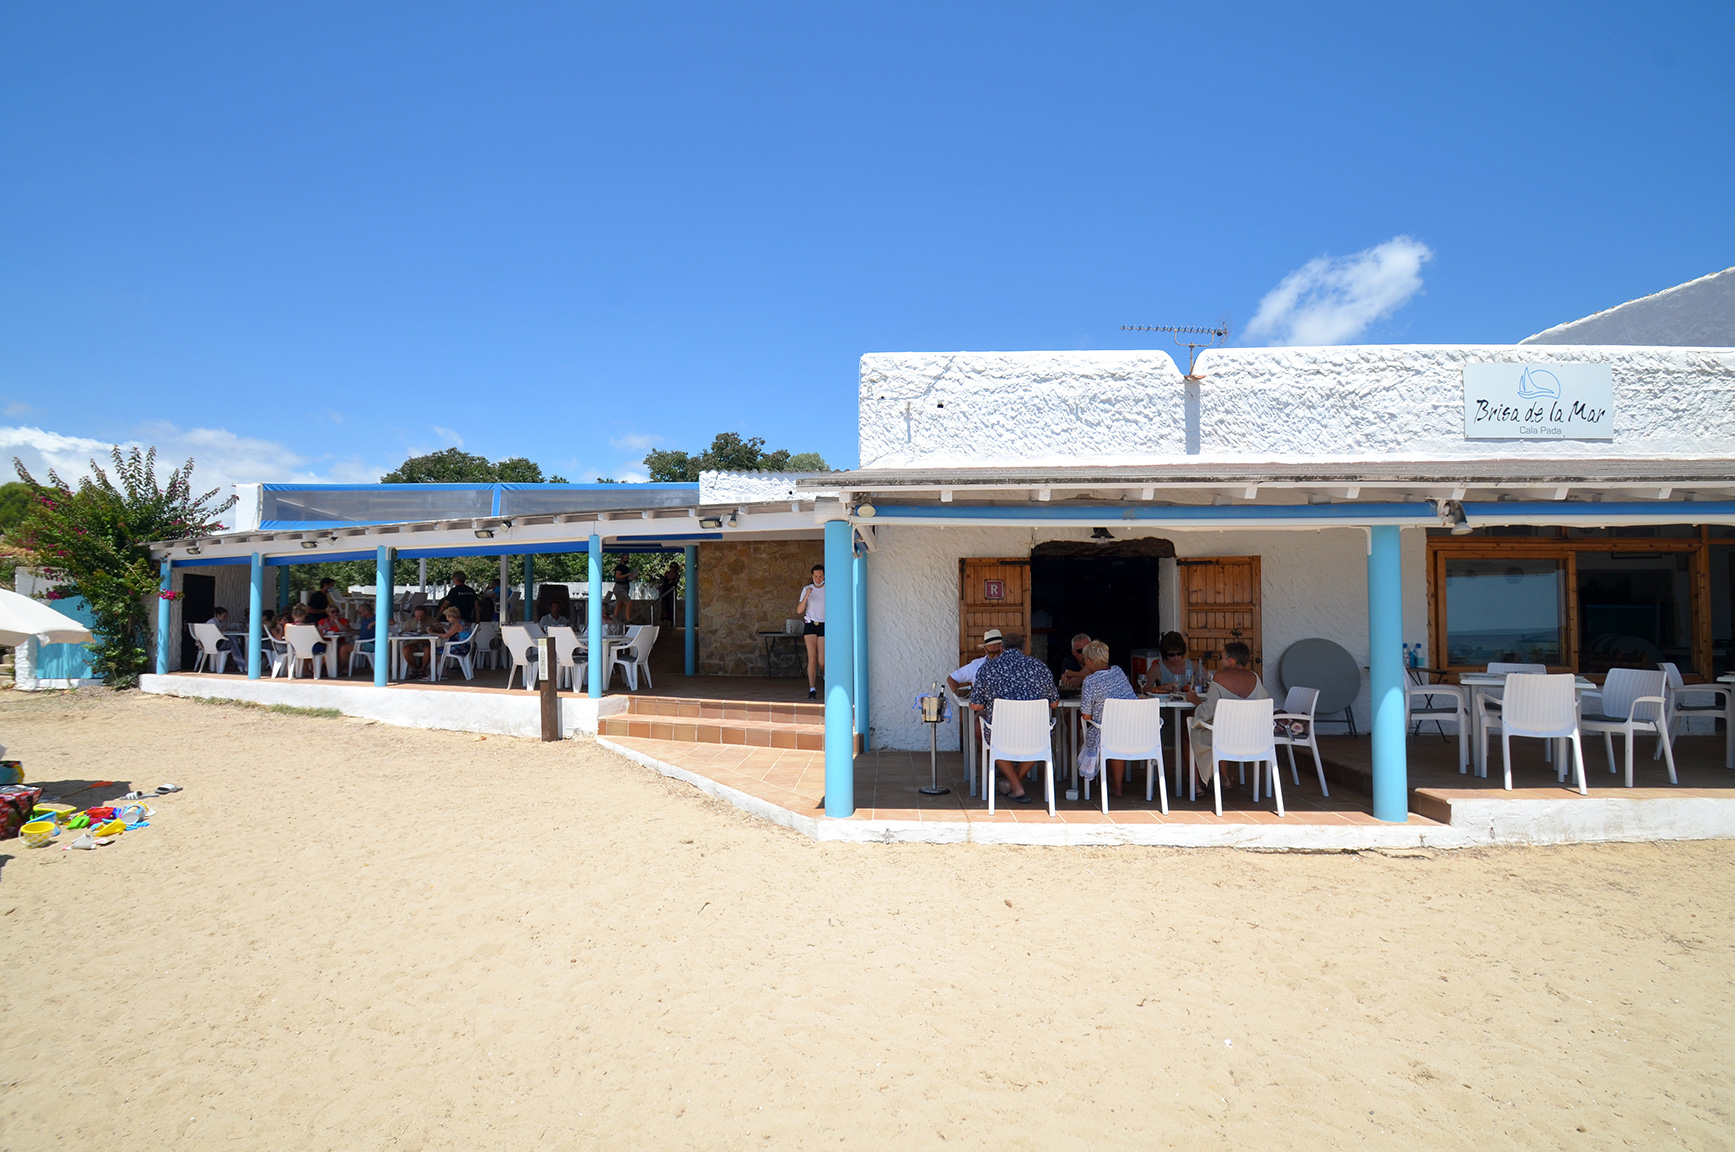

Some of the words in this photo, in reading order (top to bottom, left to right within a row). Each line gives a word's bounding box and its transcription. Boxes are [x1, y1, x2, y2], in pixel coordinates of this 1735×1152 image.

[1474, 399, 1520, 424] Brisa
[1524, 401, 1544, 423] de
[1549, 401, 1564, 423] la
[1567, 400, 1606, 424] Mar
[1519, 425, 1538, 435] Cala
[1540, 425, 1562, 435] Pada
[990, 584, 999, 595] R
